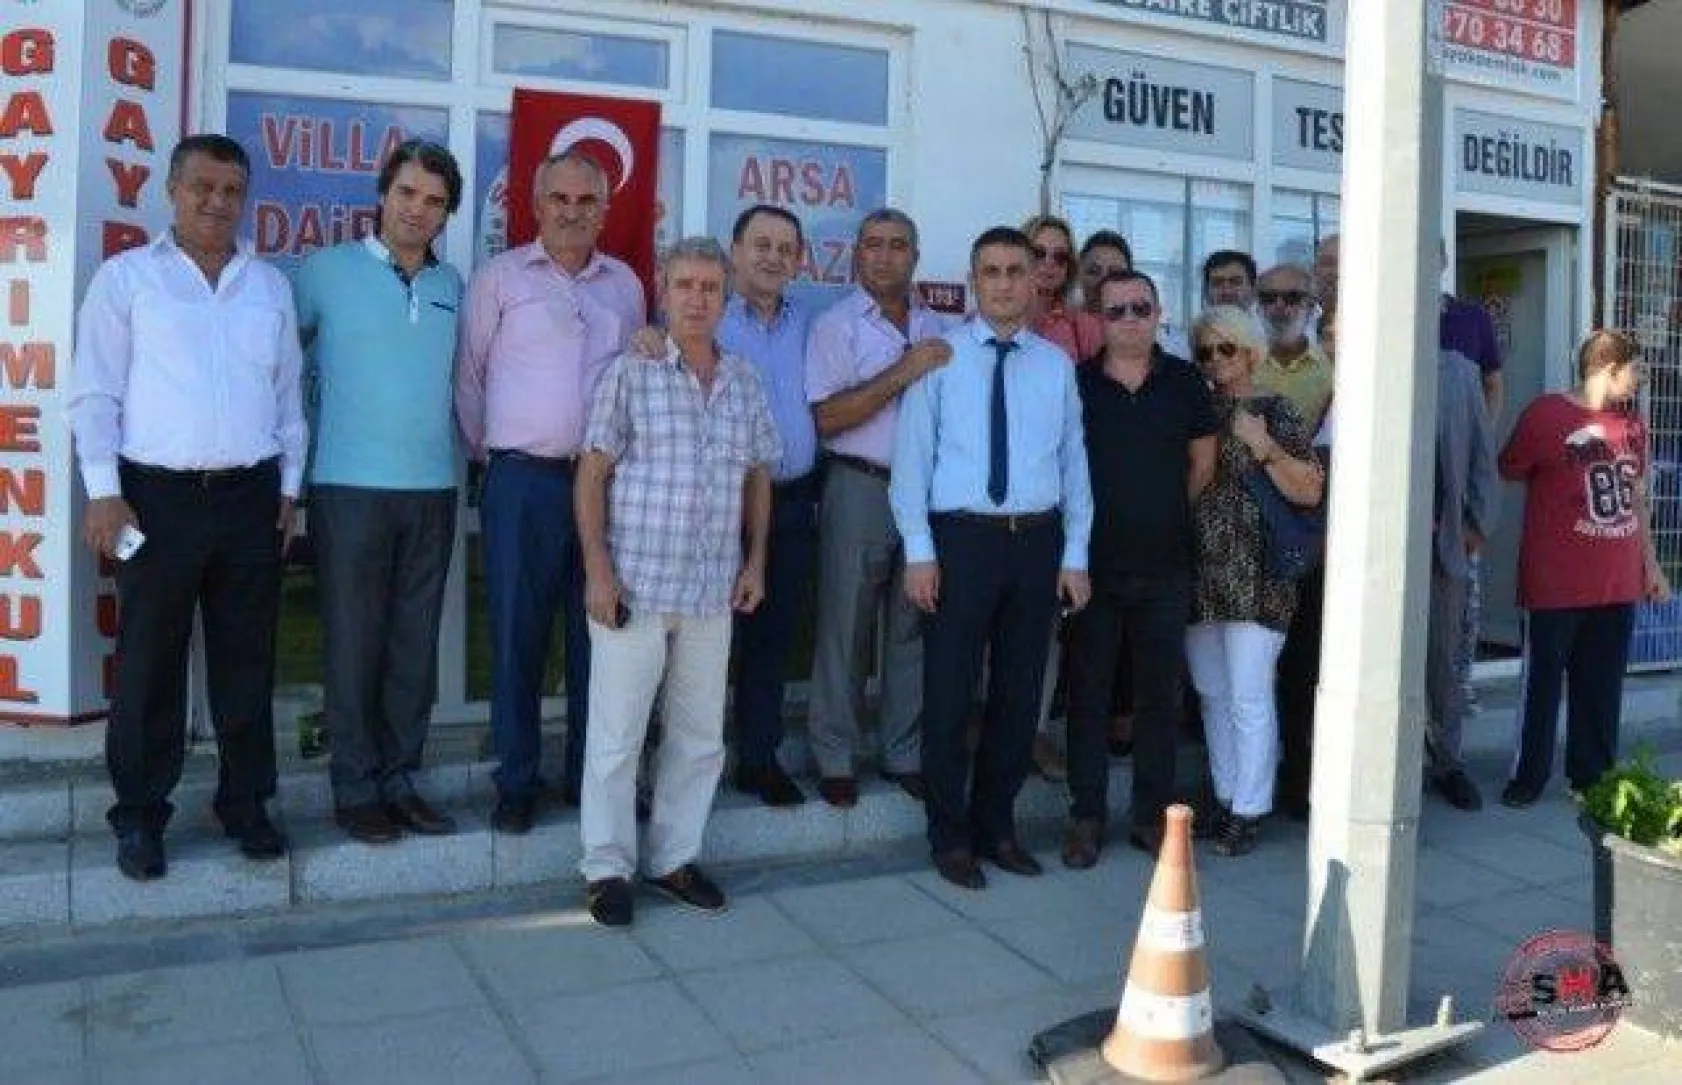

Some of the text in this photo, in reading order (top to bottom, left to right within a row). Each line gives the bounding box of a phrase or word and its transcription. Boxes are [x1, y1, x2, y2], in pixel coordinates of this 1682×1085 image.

[1494, 20, 1524, 53] 34
[1532, 30, 1562, 61] 68
[1103, 71, 1215, 135] GÜVEN
[736, 154, 856, 210] ARSA
